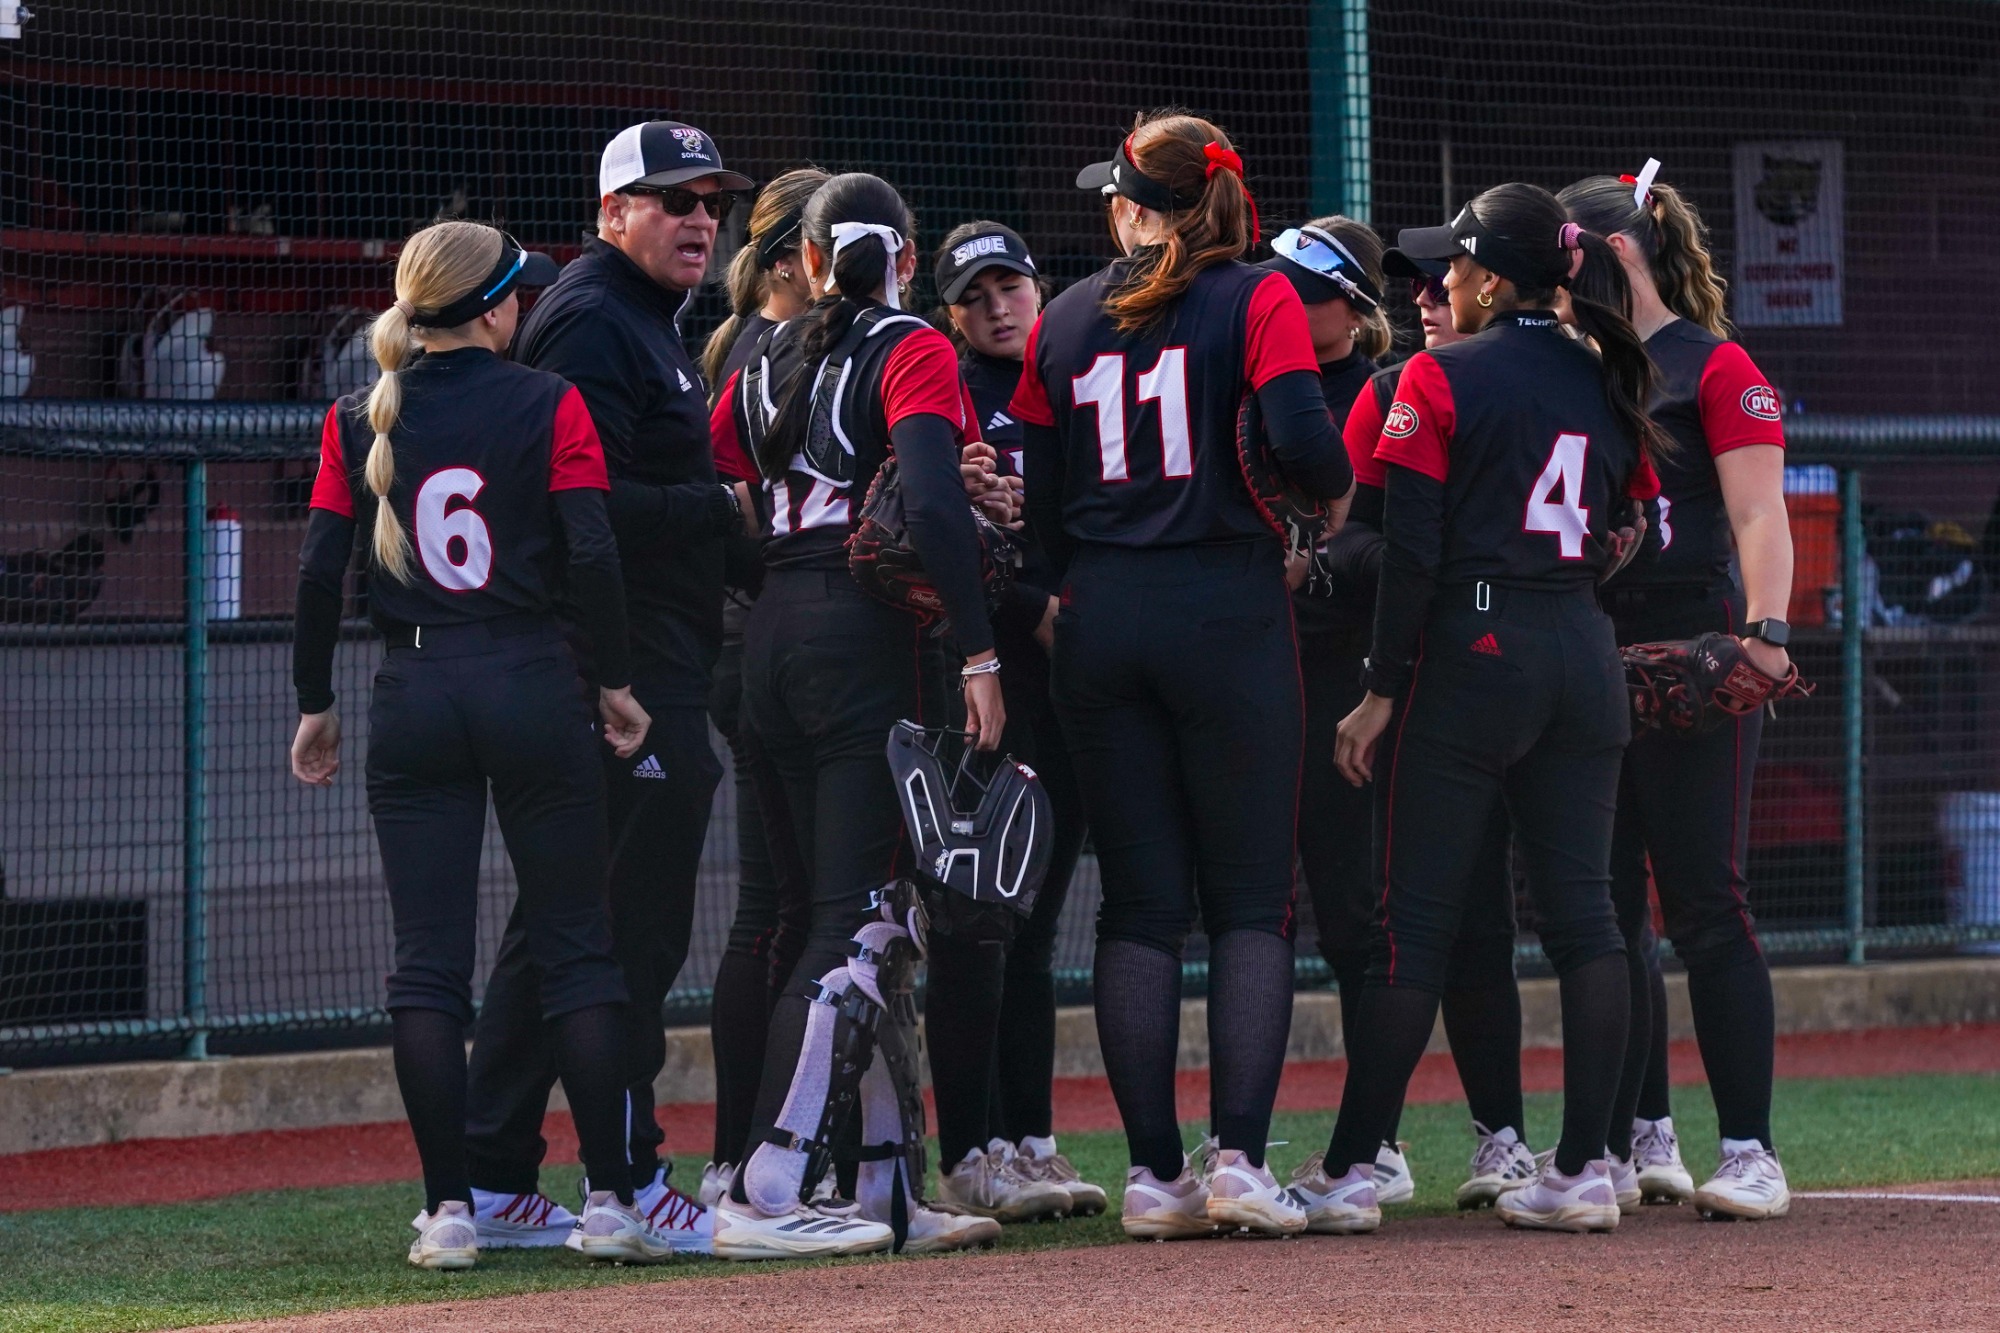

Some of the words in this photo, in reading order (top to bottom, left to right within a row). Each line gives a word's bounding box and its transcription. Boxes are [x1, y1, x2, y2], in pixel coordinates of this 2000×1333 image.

[681, 152, 712, 161] SOFTBALL
[951, 235, 1007, 267] SIUE
[1752, 395, 1777, 412] OVC
[1071, 345, 1194, 484] 11
[1386, 412, 1411, 430] OVC
[1523, 433, 1590, 560] 4
[414, 466, 493, 592] 6
[1470, 643, 1503, 657] adidas
[633, 769, 666, 779] adidas
